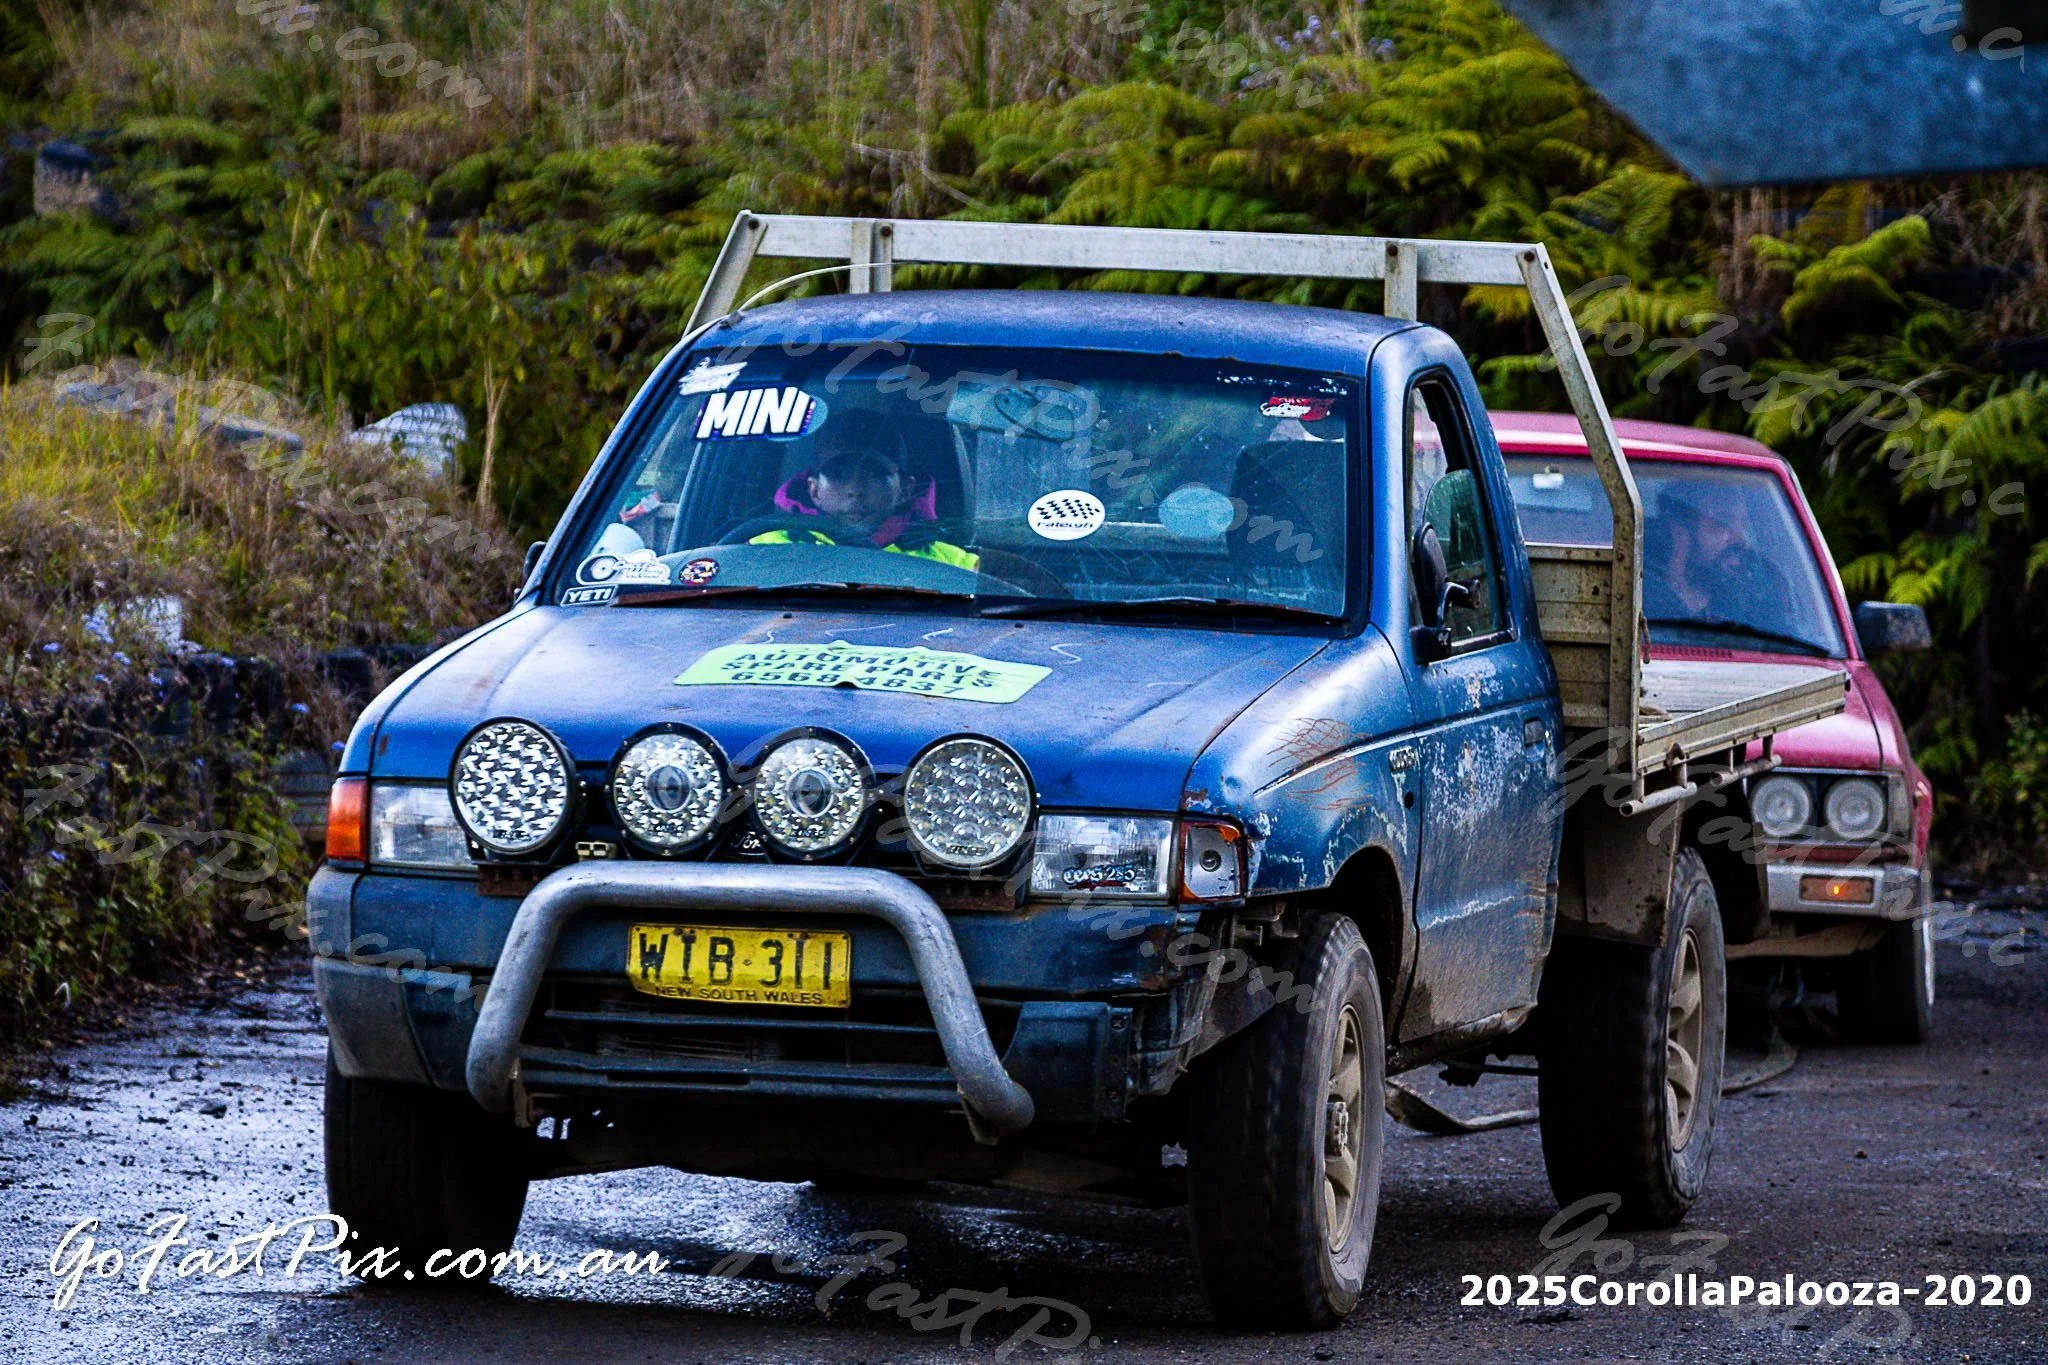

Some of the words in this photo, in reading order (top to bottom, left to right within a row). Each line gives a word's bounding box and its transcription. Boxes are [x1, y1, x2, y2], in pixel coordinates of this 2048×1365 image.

[696, 386, 811, 439] MINI
[567, 588, 613, 603] YETI
[720, 661, 850, 672] SPARE
[864, 666, 994, 688] PARTS
[736, 652, 1001, 678] AUTOMOTIVE
[730, 672, 842, 683] 6568
[655, 986, 692, 998] NEW
[699, 987, 758, 1001] SOUTH
[763, 990, 824, 1005] WALES
